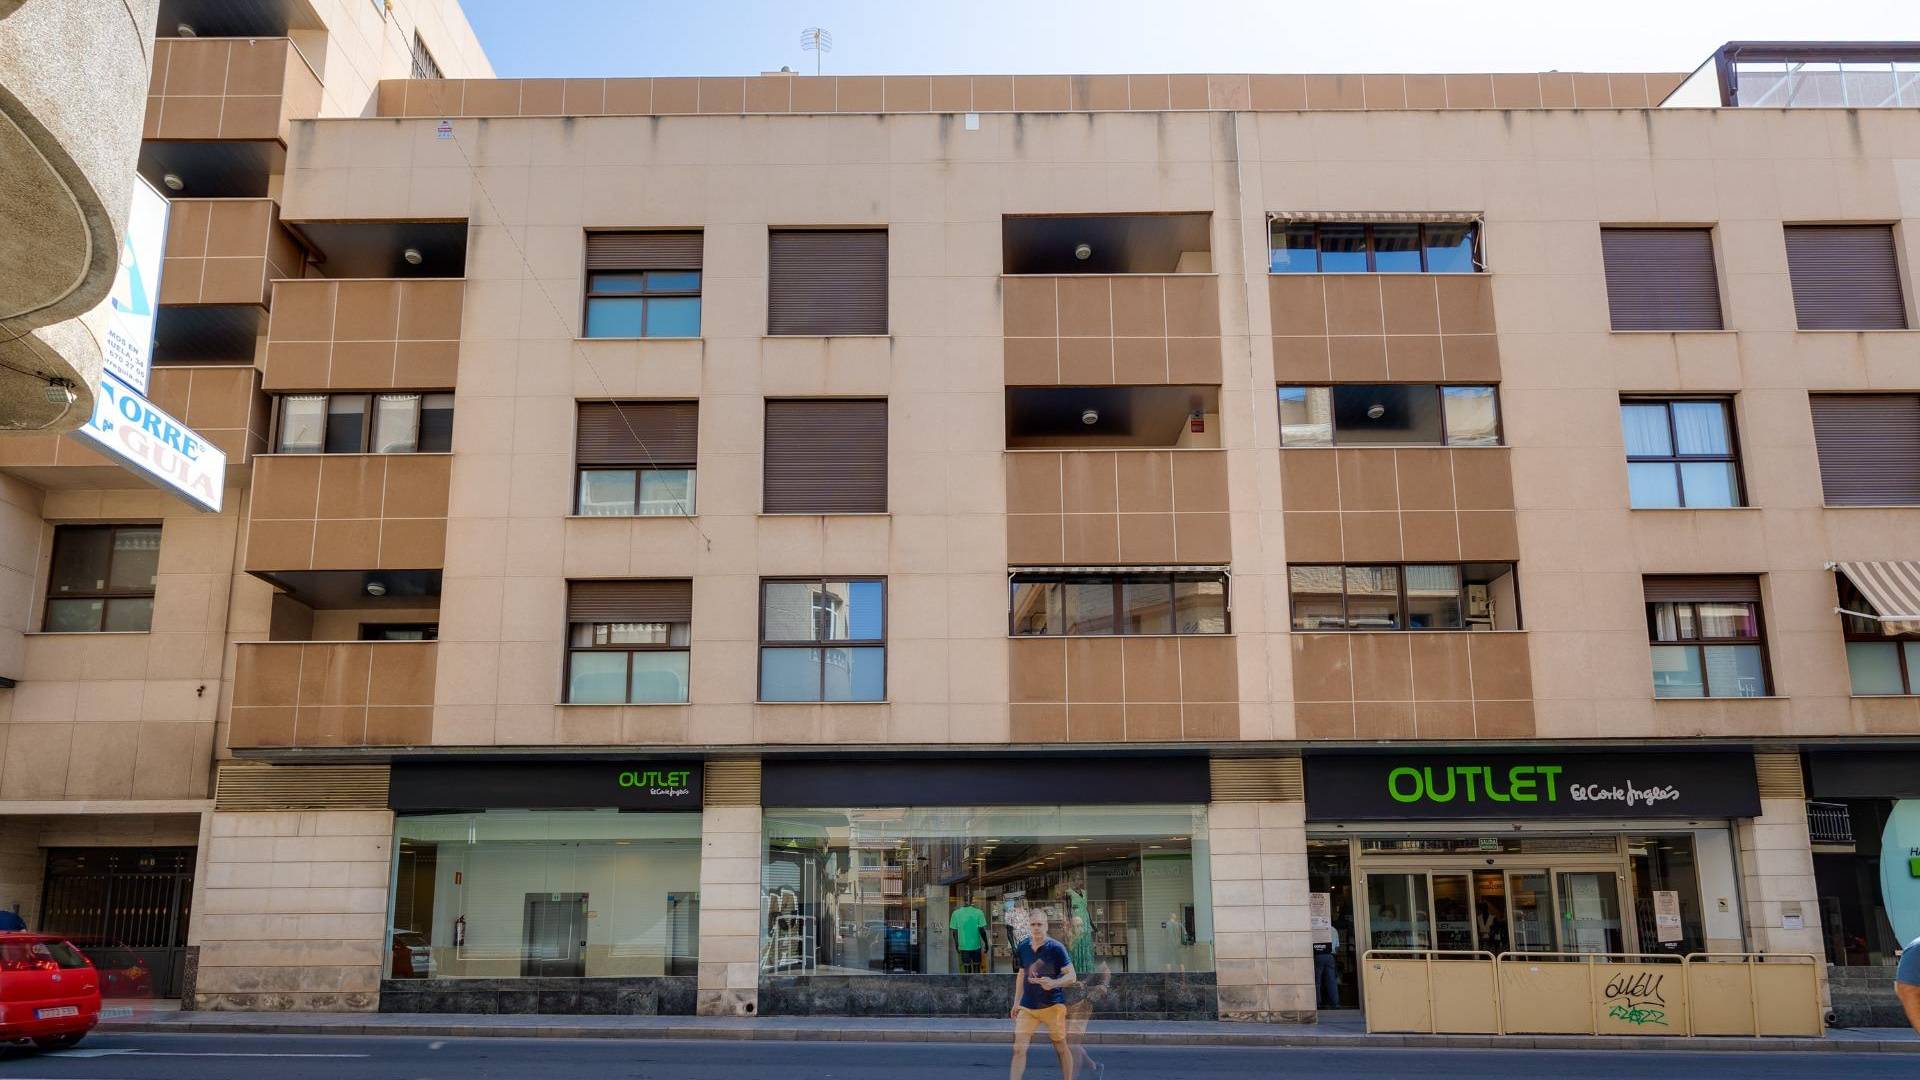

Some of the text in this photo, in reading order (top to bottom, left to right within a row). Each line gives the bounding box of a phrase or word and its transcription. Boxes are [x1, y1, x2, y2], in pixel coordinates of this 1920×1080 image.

[118, 424, 216, 501] GUIA
[619, 771, 690, 787] OUTLET
[1388, 766, 1563, 803] OUTLET
[1570, 783, 1588, 801] El
[1587, 783, 1625, 801] Corte
